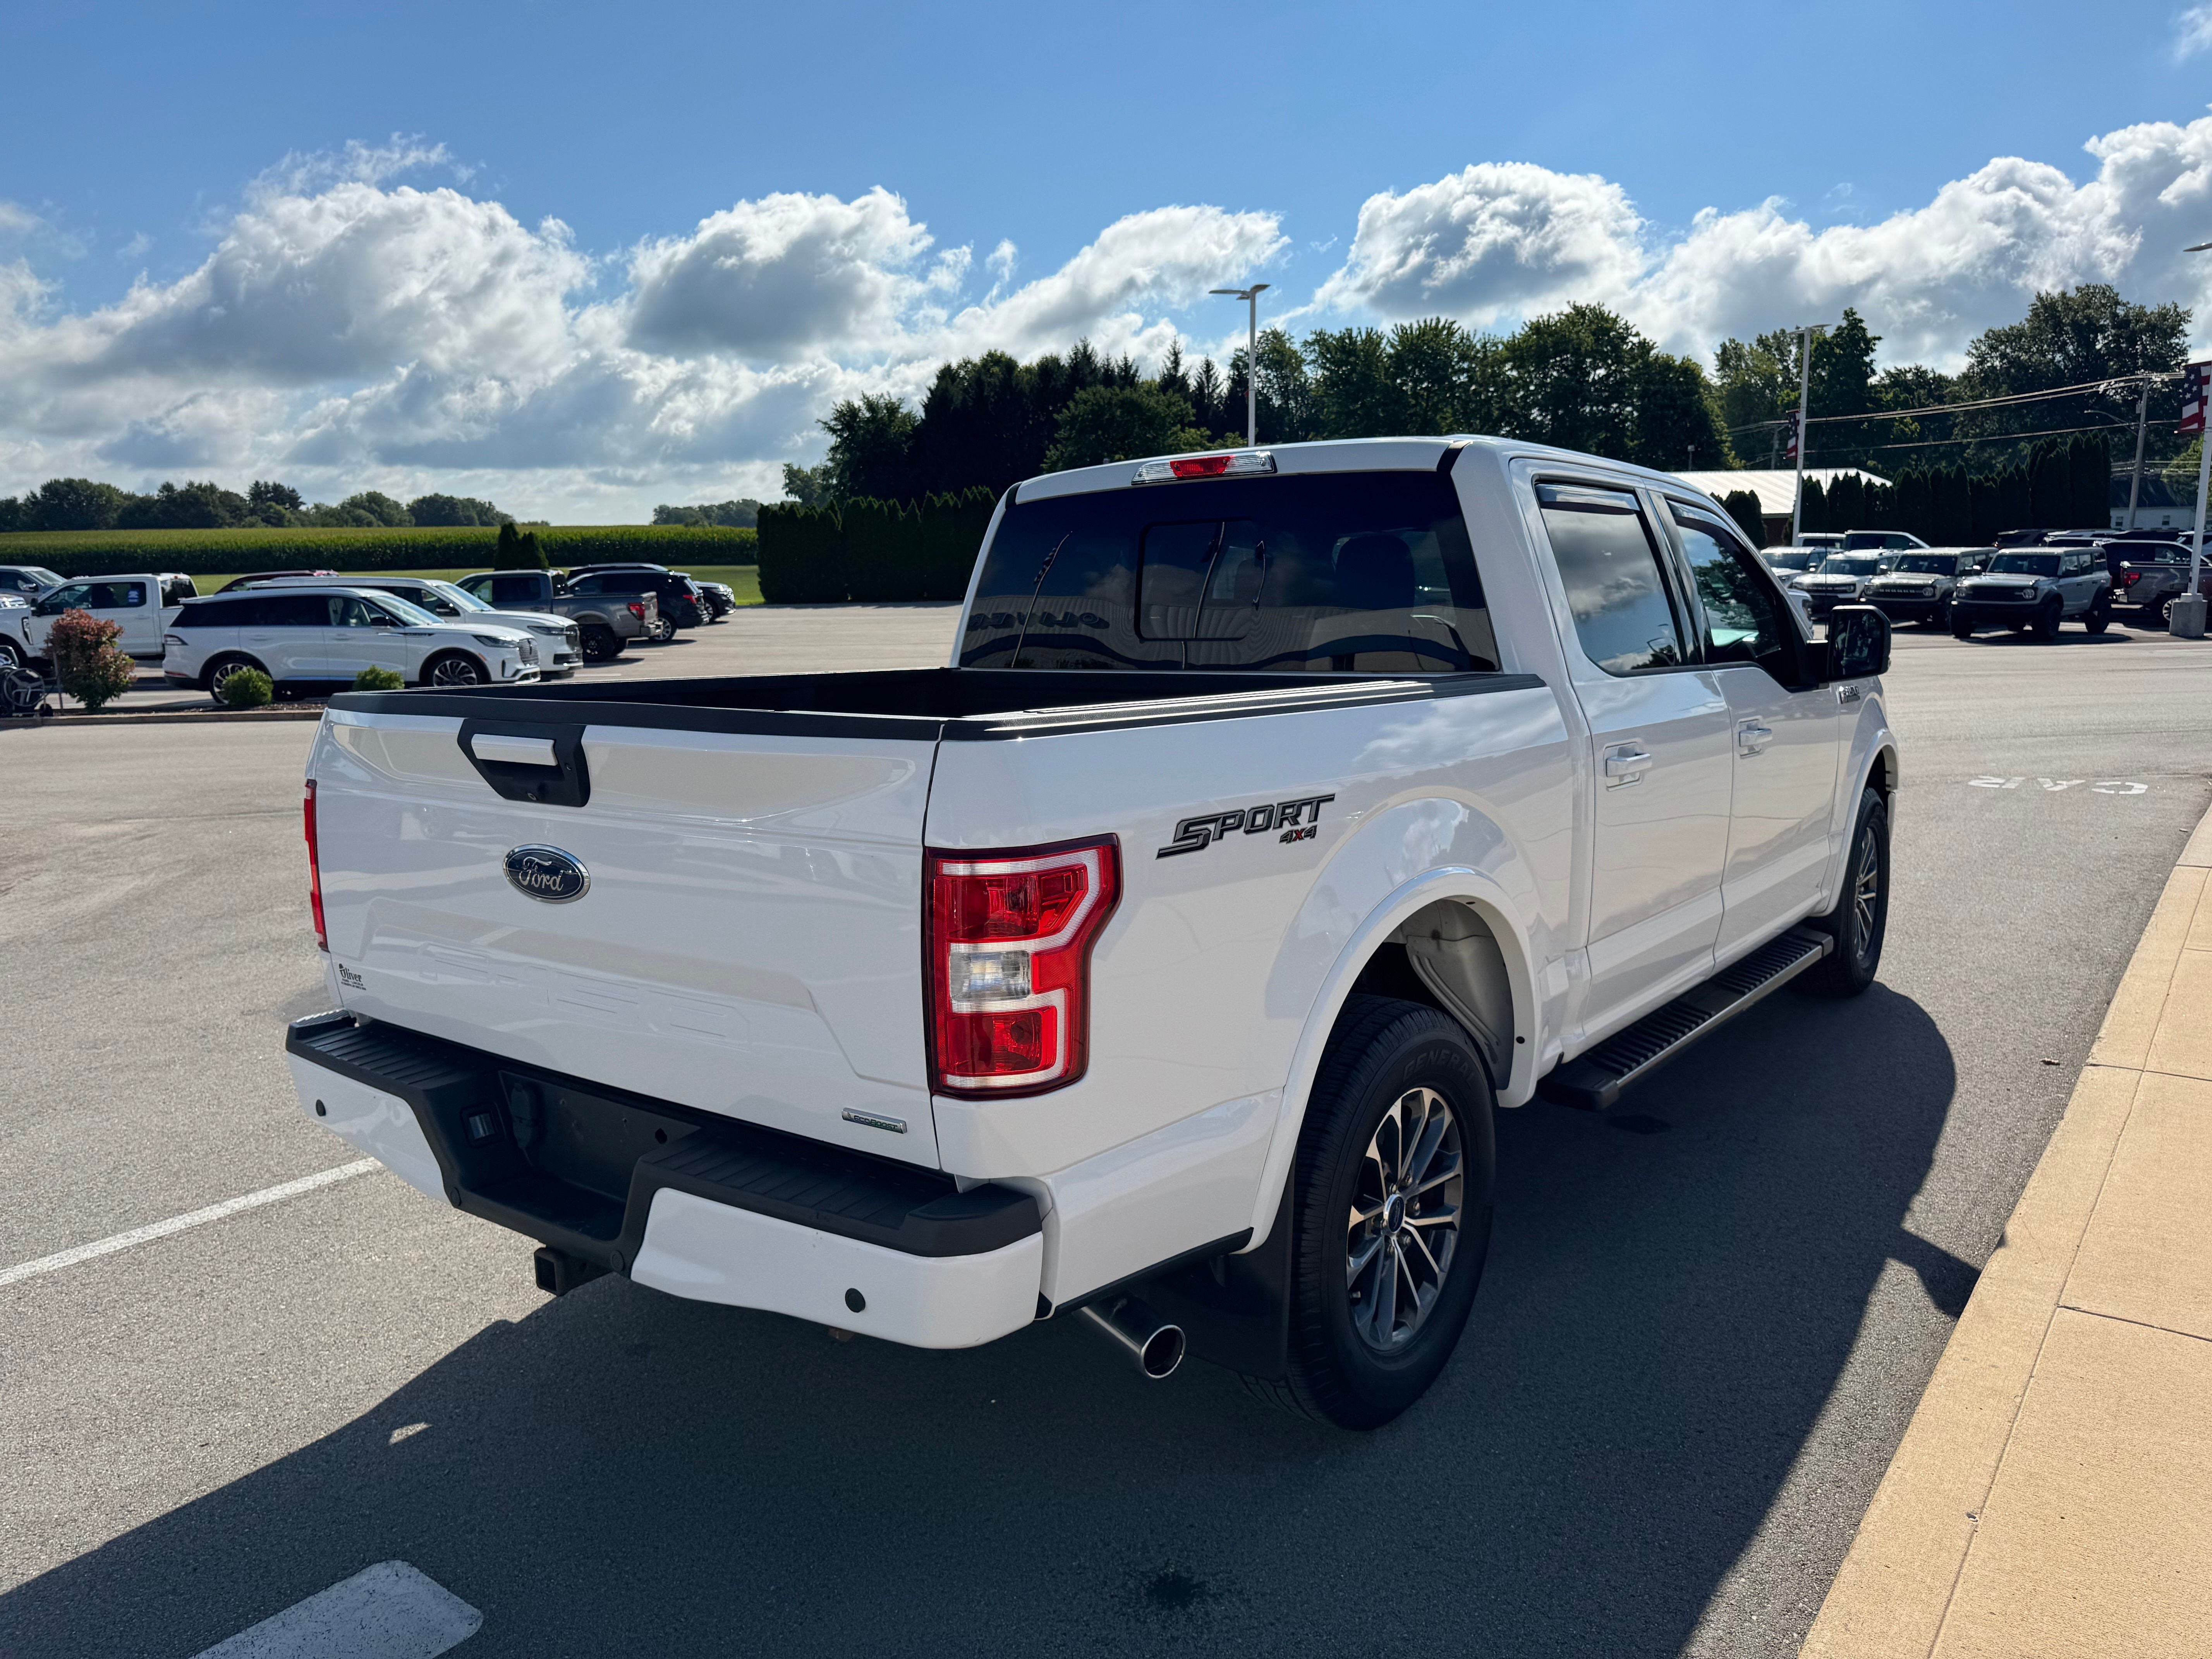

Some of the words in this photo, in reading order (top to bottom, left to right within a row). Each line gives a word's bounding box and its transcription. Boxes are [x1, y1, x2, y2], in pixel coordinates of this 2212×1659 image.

[1967, 775, 2148, 795] CAR
[1155, 793, 1336, 860] SPORT
[519, 856, 564, 891] Ford
[339, 963, 362, 982] Oliver
[1402, 1048, 1475, 1091] GENERAL
